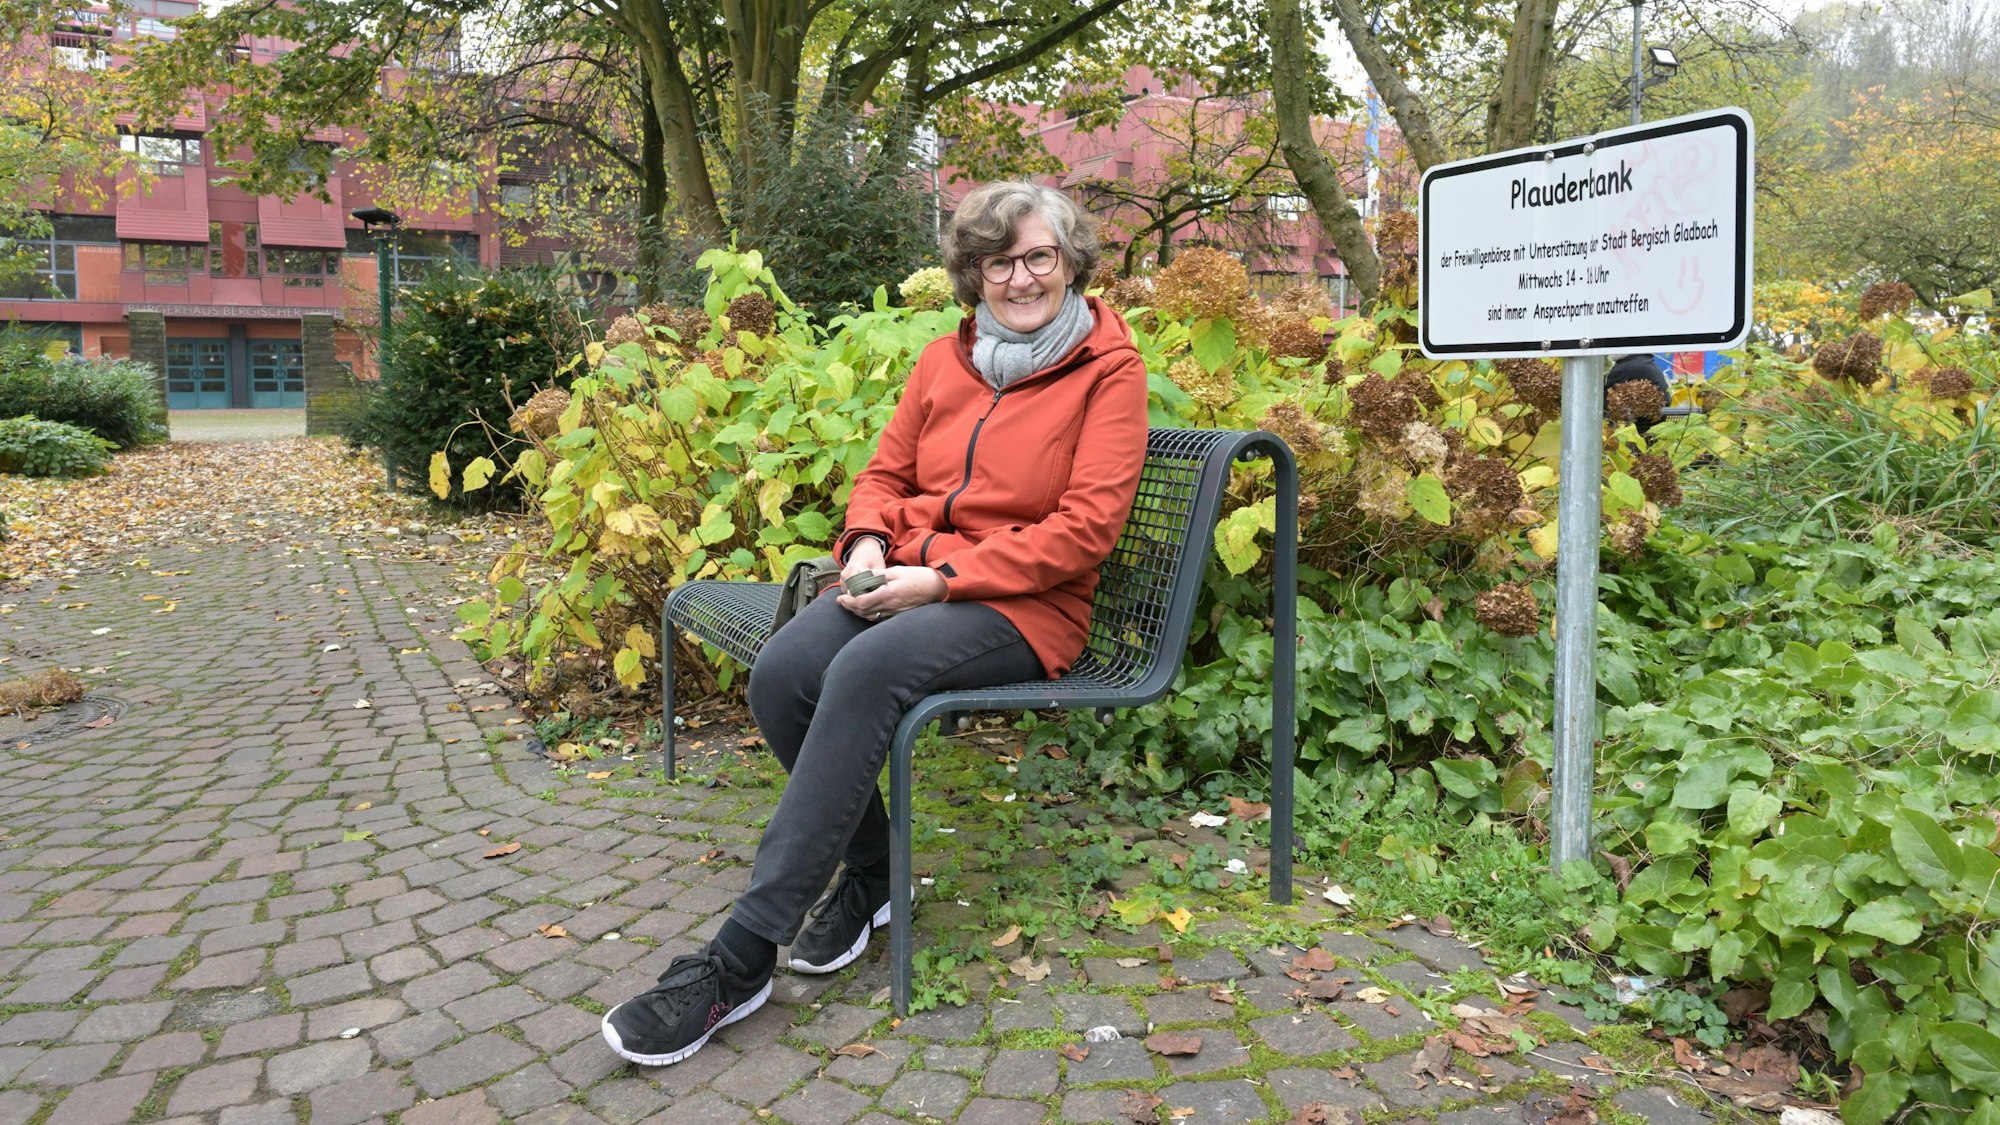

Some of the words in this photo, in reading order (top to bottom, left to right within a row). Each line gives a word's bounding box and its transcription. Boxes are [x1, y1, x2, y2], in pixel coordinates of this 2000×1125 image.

[1511, 159, 1633, 209] Plauderbank
[1441, 252, 1452, 267] der
[1454, 247, 1511, 269] Freiwilligenbörse
[1513, 243, 1526, 261] mit
[1529, 240, 1588, 259] Unterstützung
[1589, 234, 1599, 252] der
[1601, 230, 1628, 251] Stadt
[1631, 224, 1670, 251] Bergisch
[1673, 218, 1718, 243] Gladbach
[1518, 270, 1563, 289] Mittwochs
[1566, 268, 1576, 286] 14
[1594, 264, 1609, 283] Uhr
[223, 306, 301, 318] BERGISCHER
[1488, 304, 1502, 321] sind
[1504, 304, 1527, 320] immer
[1596, 293, 1649, 314] anzutreffen
